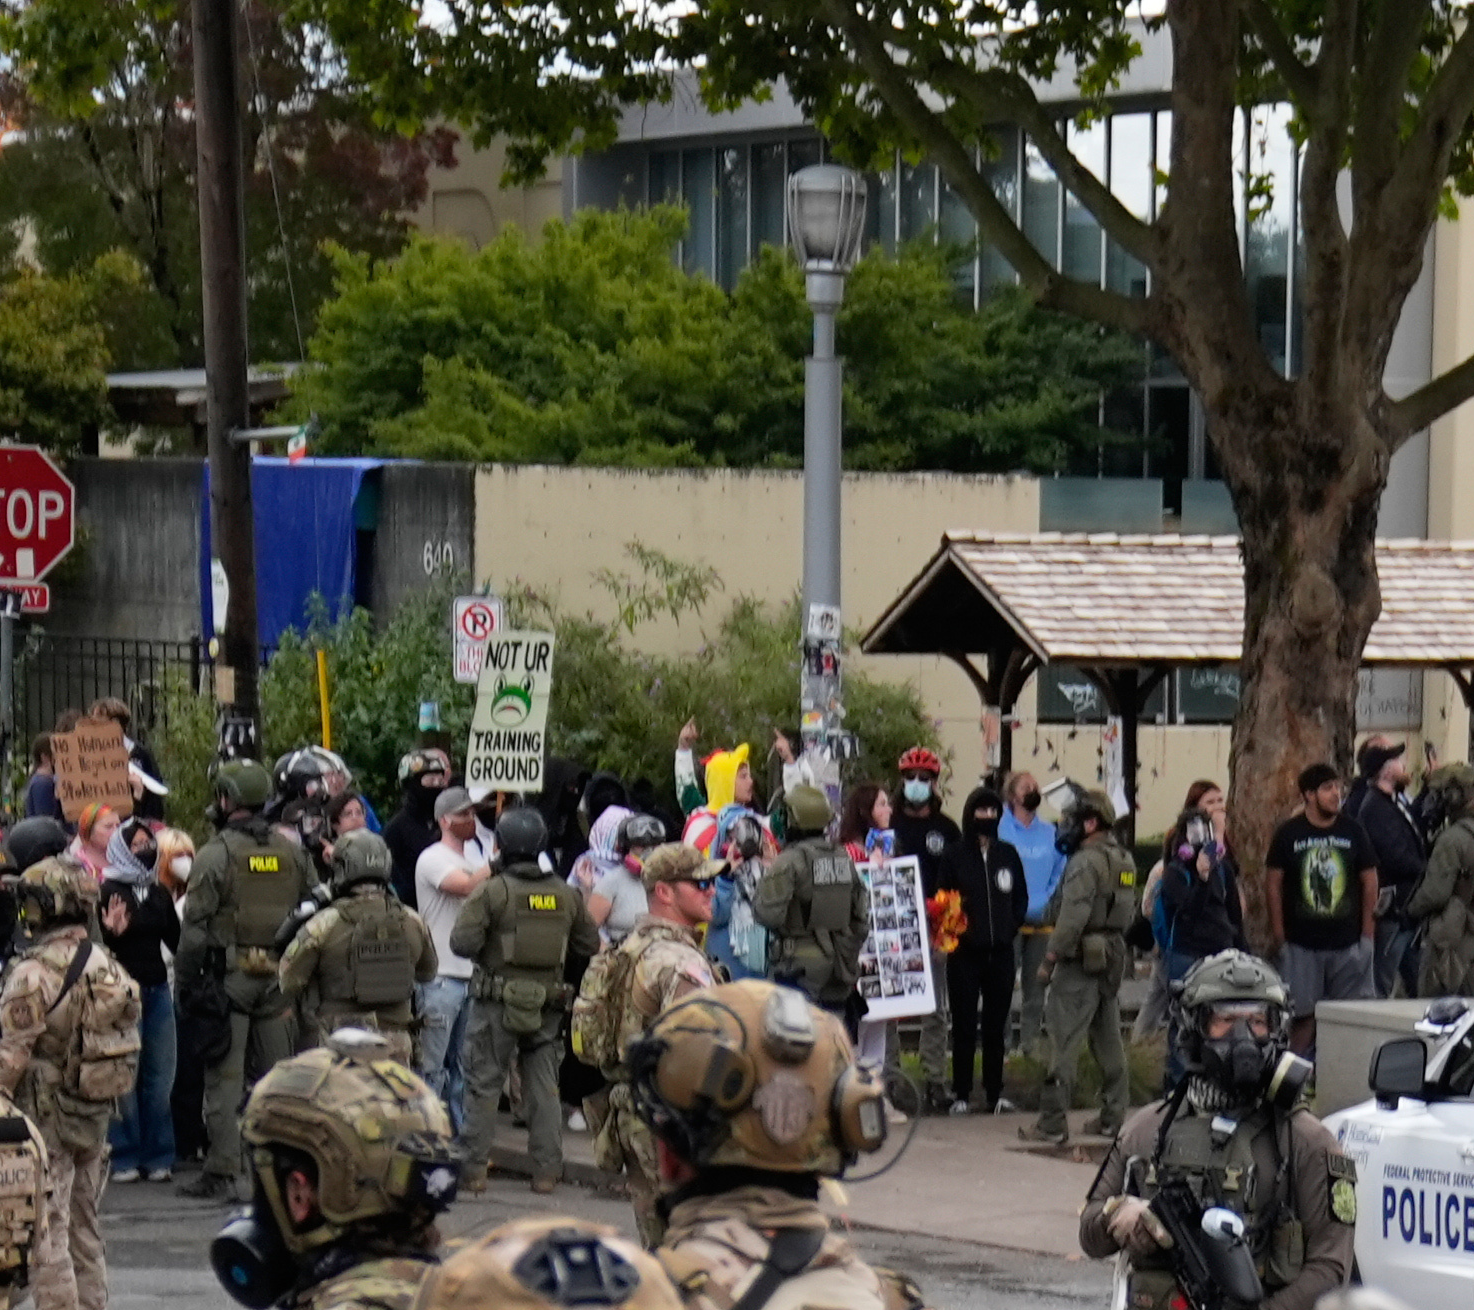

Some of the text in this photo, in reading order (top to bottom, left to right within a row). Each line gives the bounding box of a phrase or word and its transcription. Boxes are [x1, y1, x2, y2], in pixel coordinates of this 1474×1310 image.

[423, 541, 453, 575] 640
[485, 641, 550, 673] NOT UR
[472, 729, 541, 753] TRAINING
[470, 756, 540, 782] GROUND
[249, 856, 278, 873] POLICE
[529, 895, 556, 910] POLICE
[1383, 1163, 1410, 1180] FEDERAL
[1412, 1166, 1451, 1187] PROTECTIVE
